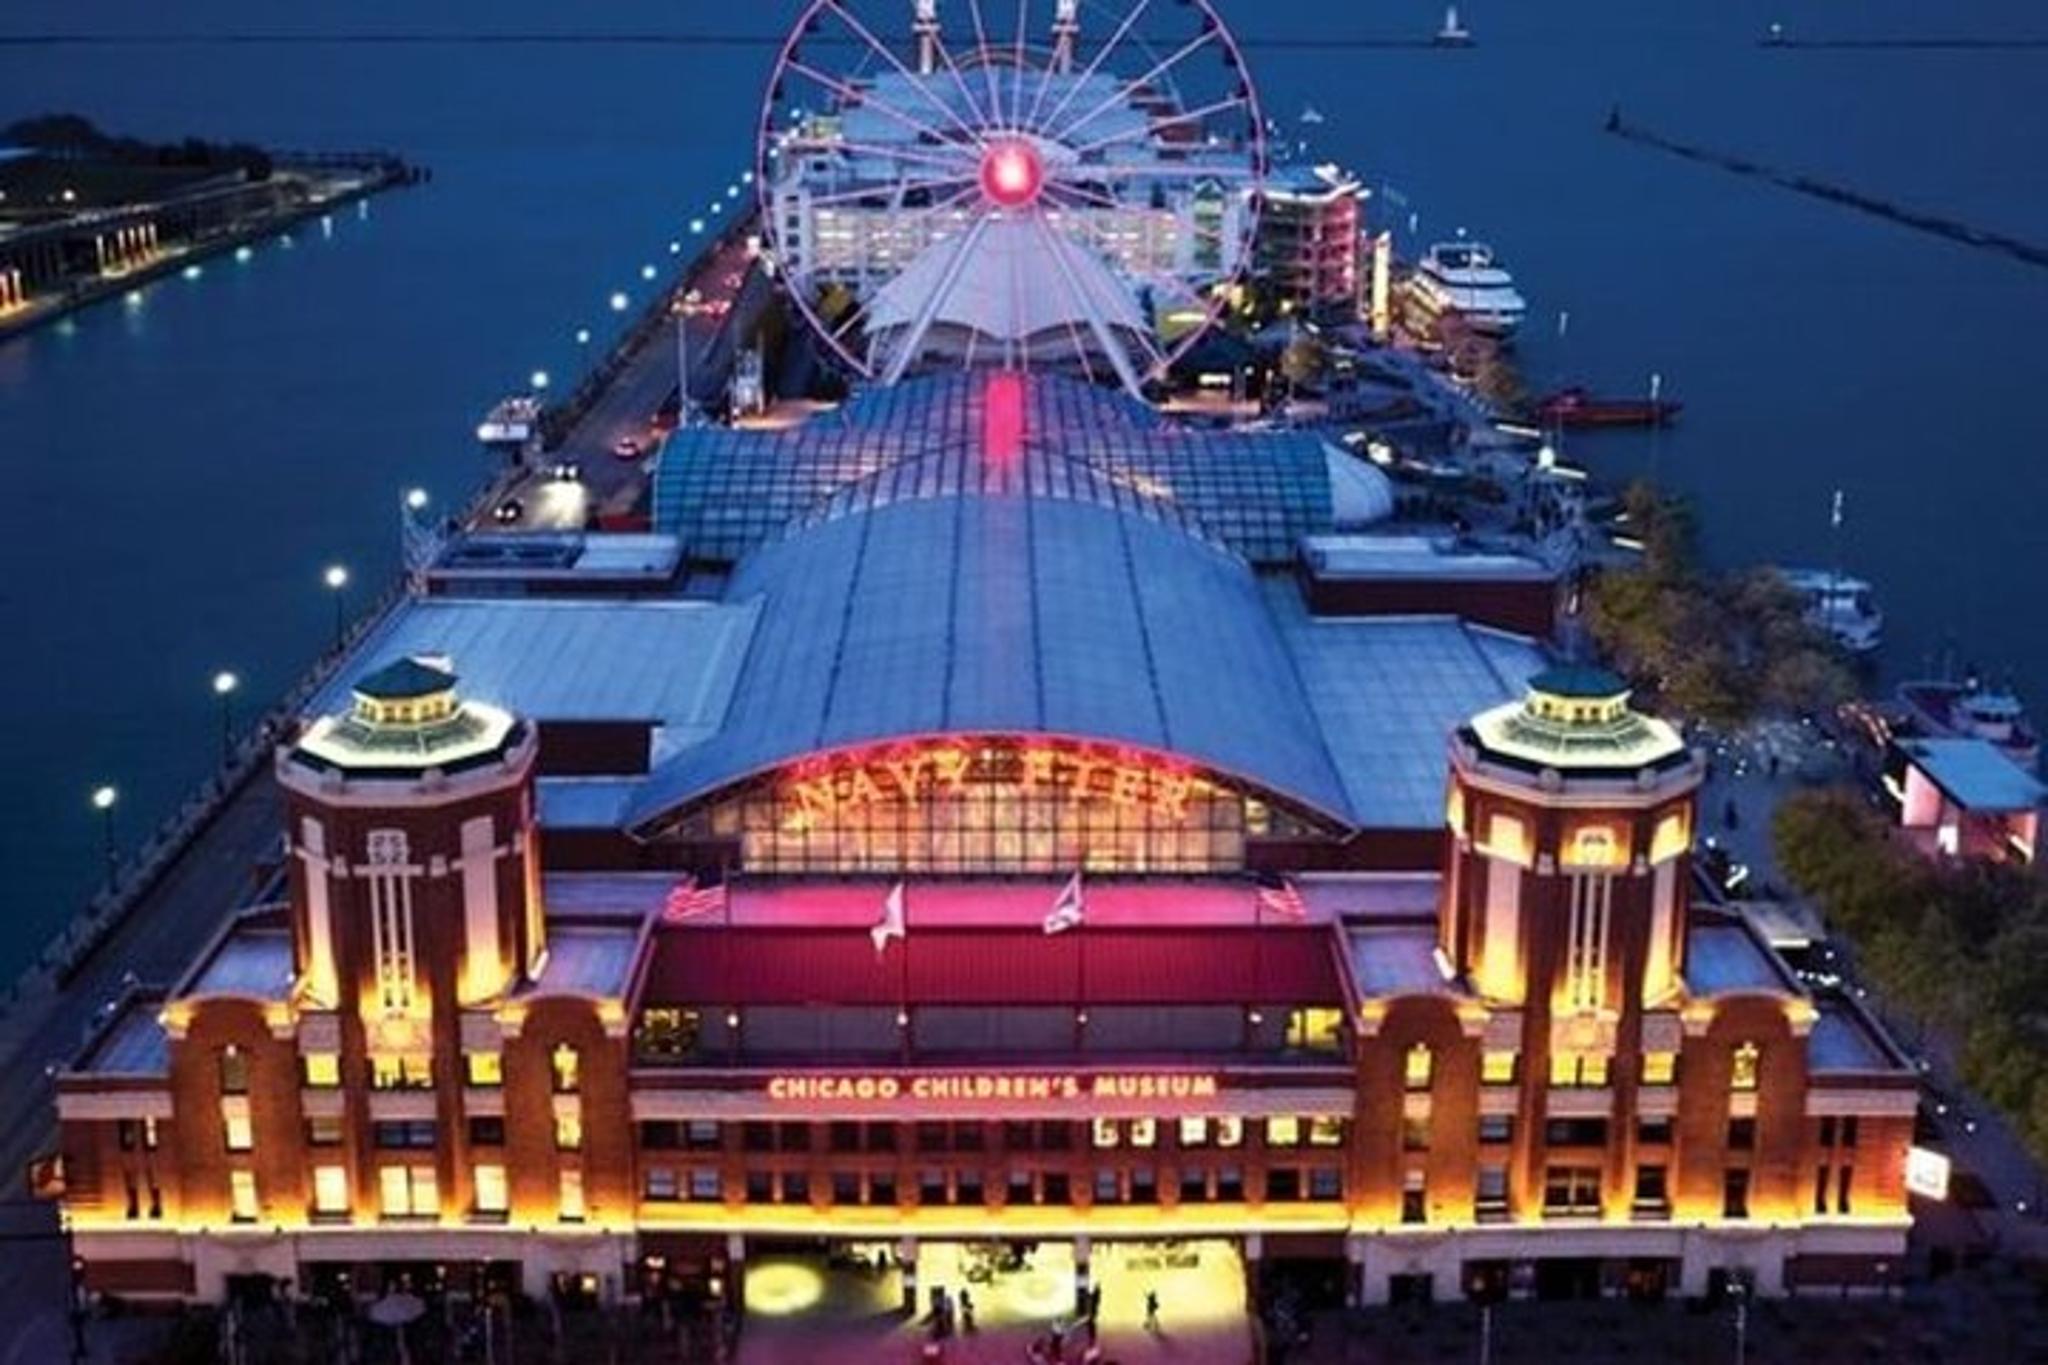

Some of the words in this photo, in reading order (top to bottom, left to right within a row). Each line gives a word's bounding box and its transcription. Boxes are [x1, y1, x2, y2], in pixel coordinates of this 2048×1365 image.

[793, 750, 972, 818] NAVY
[1021, 750, 1189, 819] PIER
[769, 1077, 900, 1099] CHICAGO
[911, 1076, 1079, 1098] CHILDREN'S
[1093, 1075, 1217, 1097] MUSEUM
